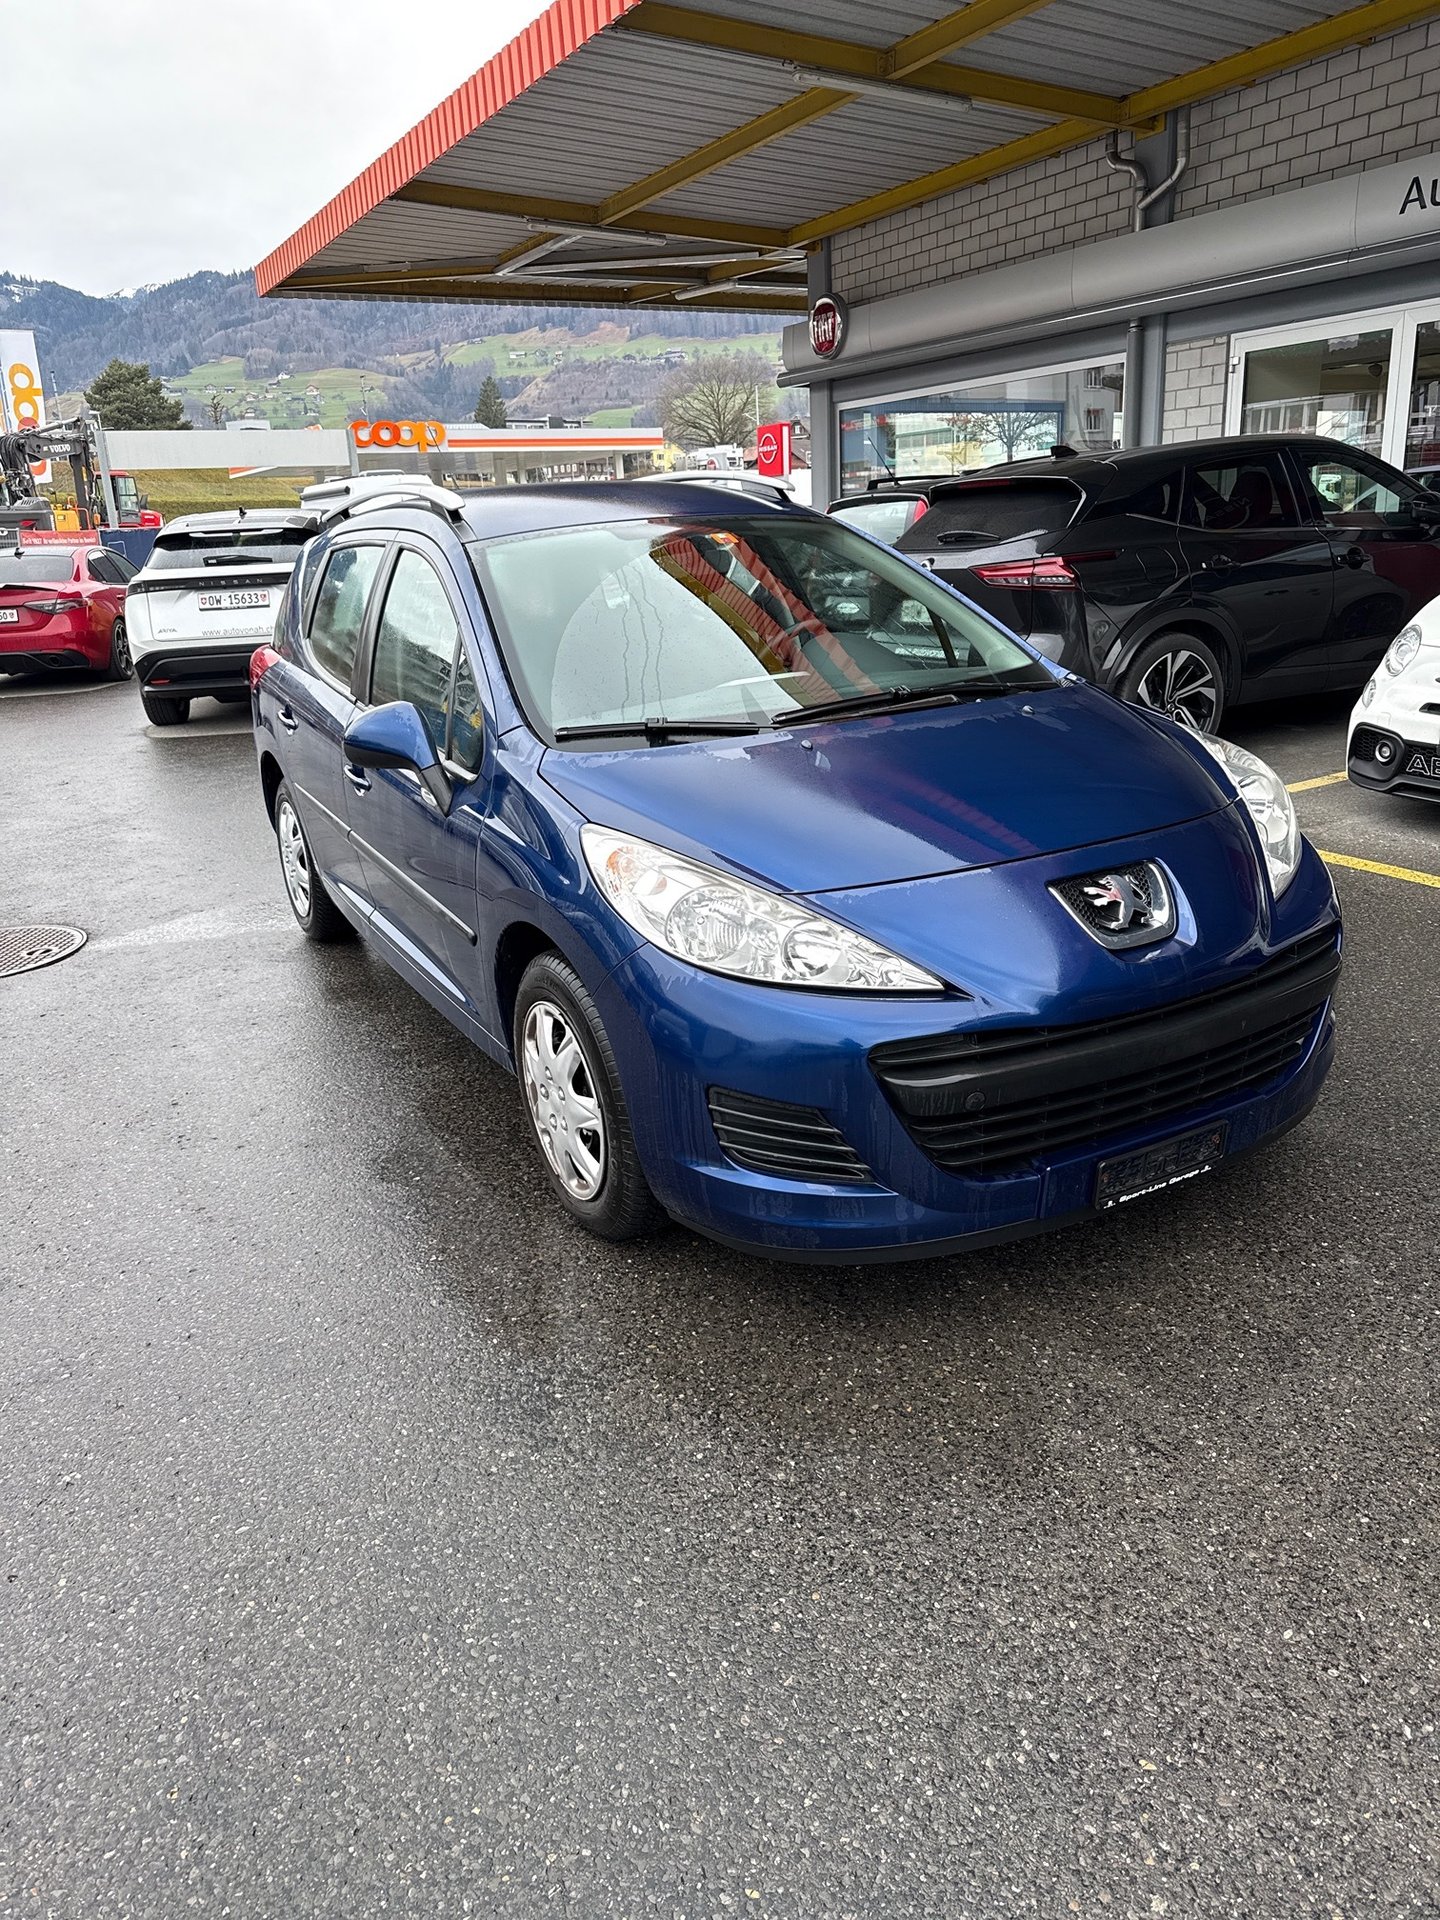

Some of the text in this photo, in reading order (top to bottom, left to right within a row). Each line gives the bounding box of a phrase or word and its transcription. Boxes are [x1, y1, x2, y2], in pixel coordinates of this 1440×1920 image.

[813, 311, 834, 343] FIAT
[348, 420, 446, 453] coop
[50, 443, 71, 453] VOLVO
[758, 444, 778, 453] NISSAN
[199, 578, 263, 587] NISSAN
[1169, 1169, 1200, 1185] Garage
